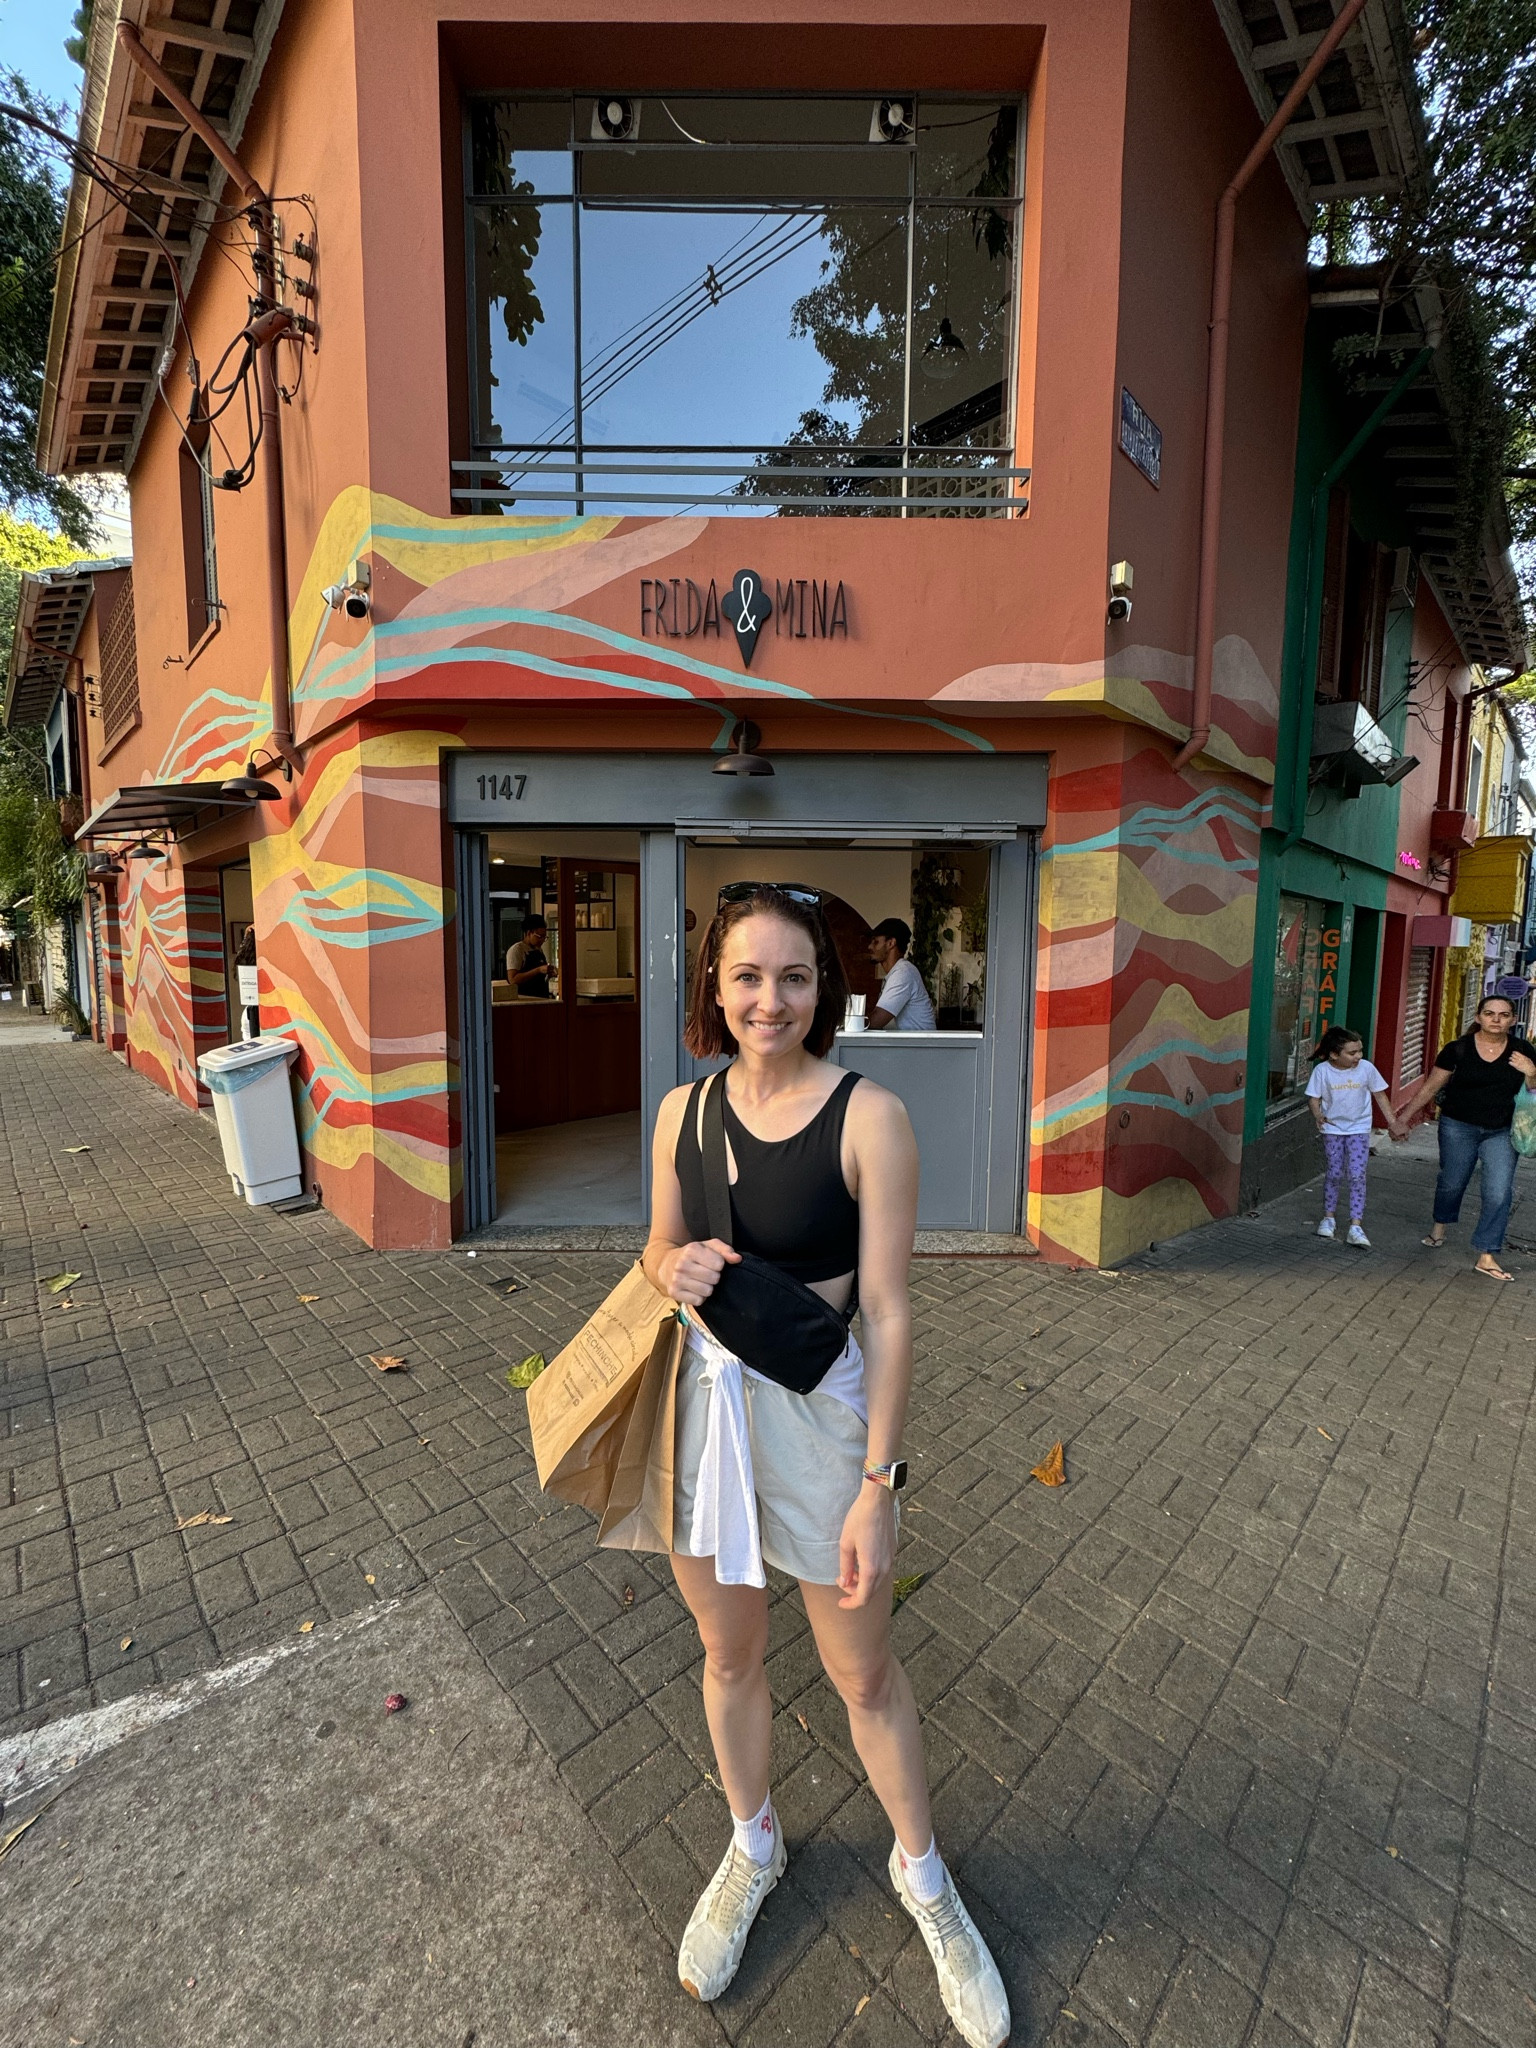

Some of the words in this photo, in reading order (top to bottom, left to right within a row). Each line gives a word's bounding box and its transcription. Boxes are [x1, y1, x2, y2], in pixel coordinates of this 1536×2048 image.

[1132, 403, 1153, 444] RUA
[640, 578, 720, 637] FRIDA
[737, 577, 756, 633] &
[776, 578, 848, 638] MINA
[477, 774, 527, 800] 1147
